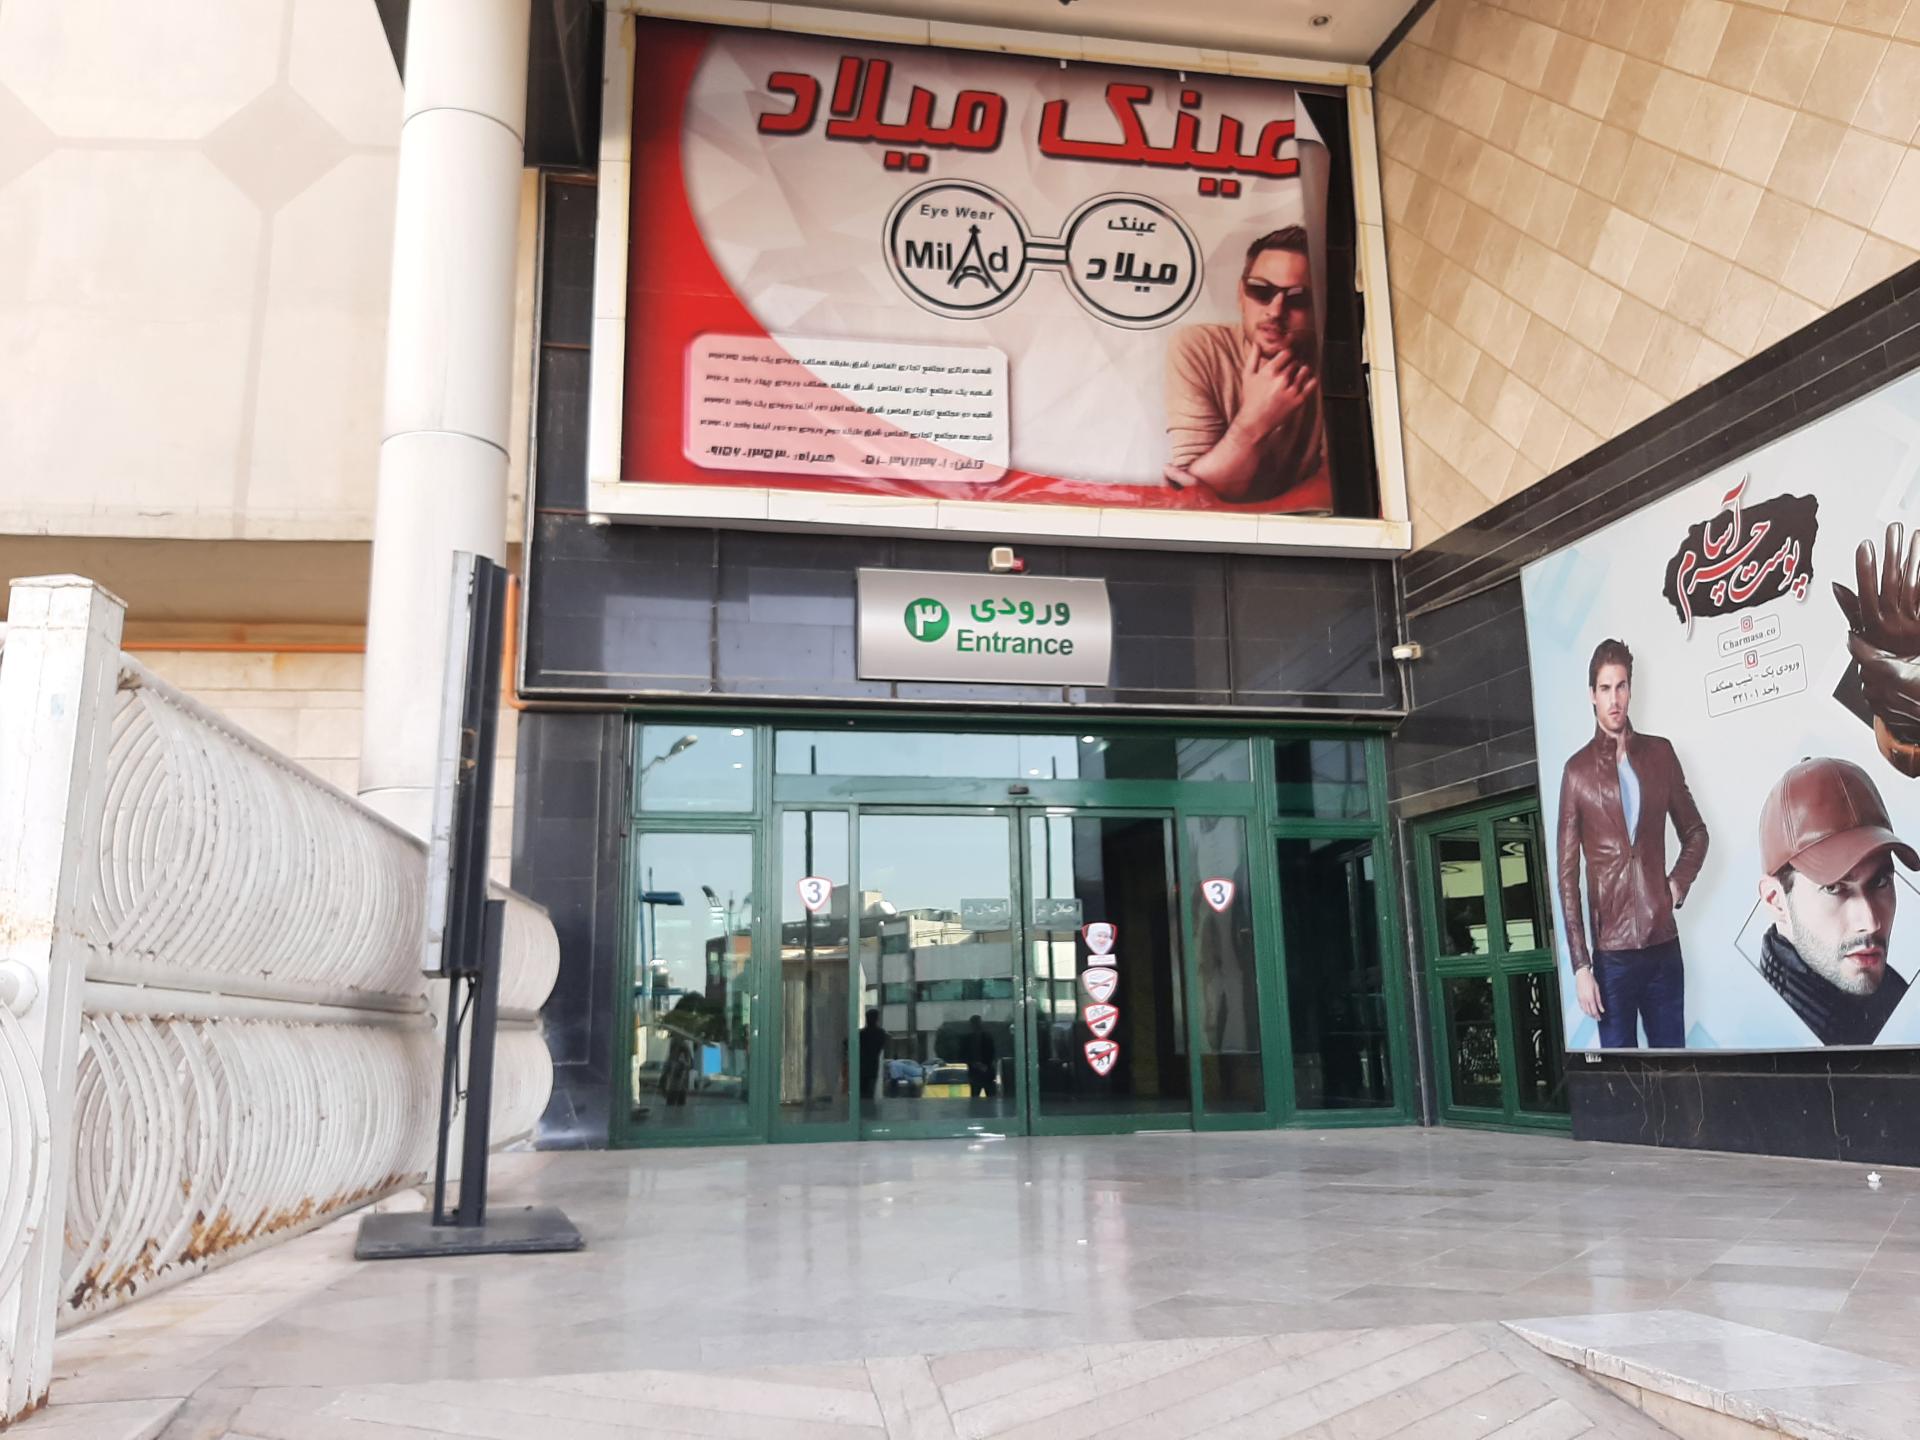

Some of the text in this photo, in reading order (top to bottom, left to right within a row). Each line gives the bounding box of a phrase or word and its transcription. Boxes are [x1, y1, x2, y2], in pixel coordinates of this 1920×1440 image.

[757, 55, 1301, 198] عینک میلاد
[920, 203, 996, 221] Eye Wear
[1107, 216, 1157, 237] عینک
[1086, 252, 1179, 293] میلاد
[914, 604, 943, 637] ۳
[970, 596, 1071, 626] ورودی
[956, 628, 1074, 655] Entrance
[1776, 661, 1800, 676] ورودی
[1762, 682, 1779, 695] واحد
[806, 880, 824, 905] 3
[1211, 882, 1226, 905] 3
